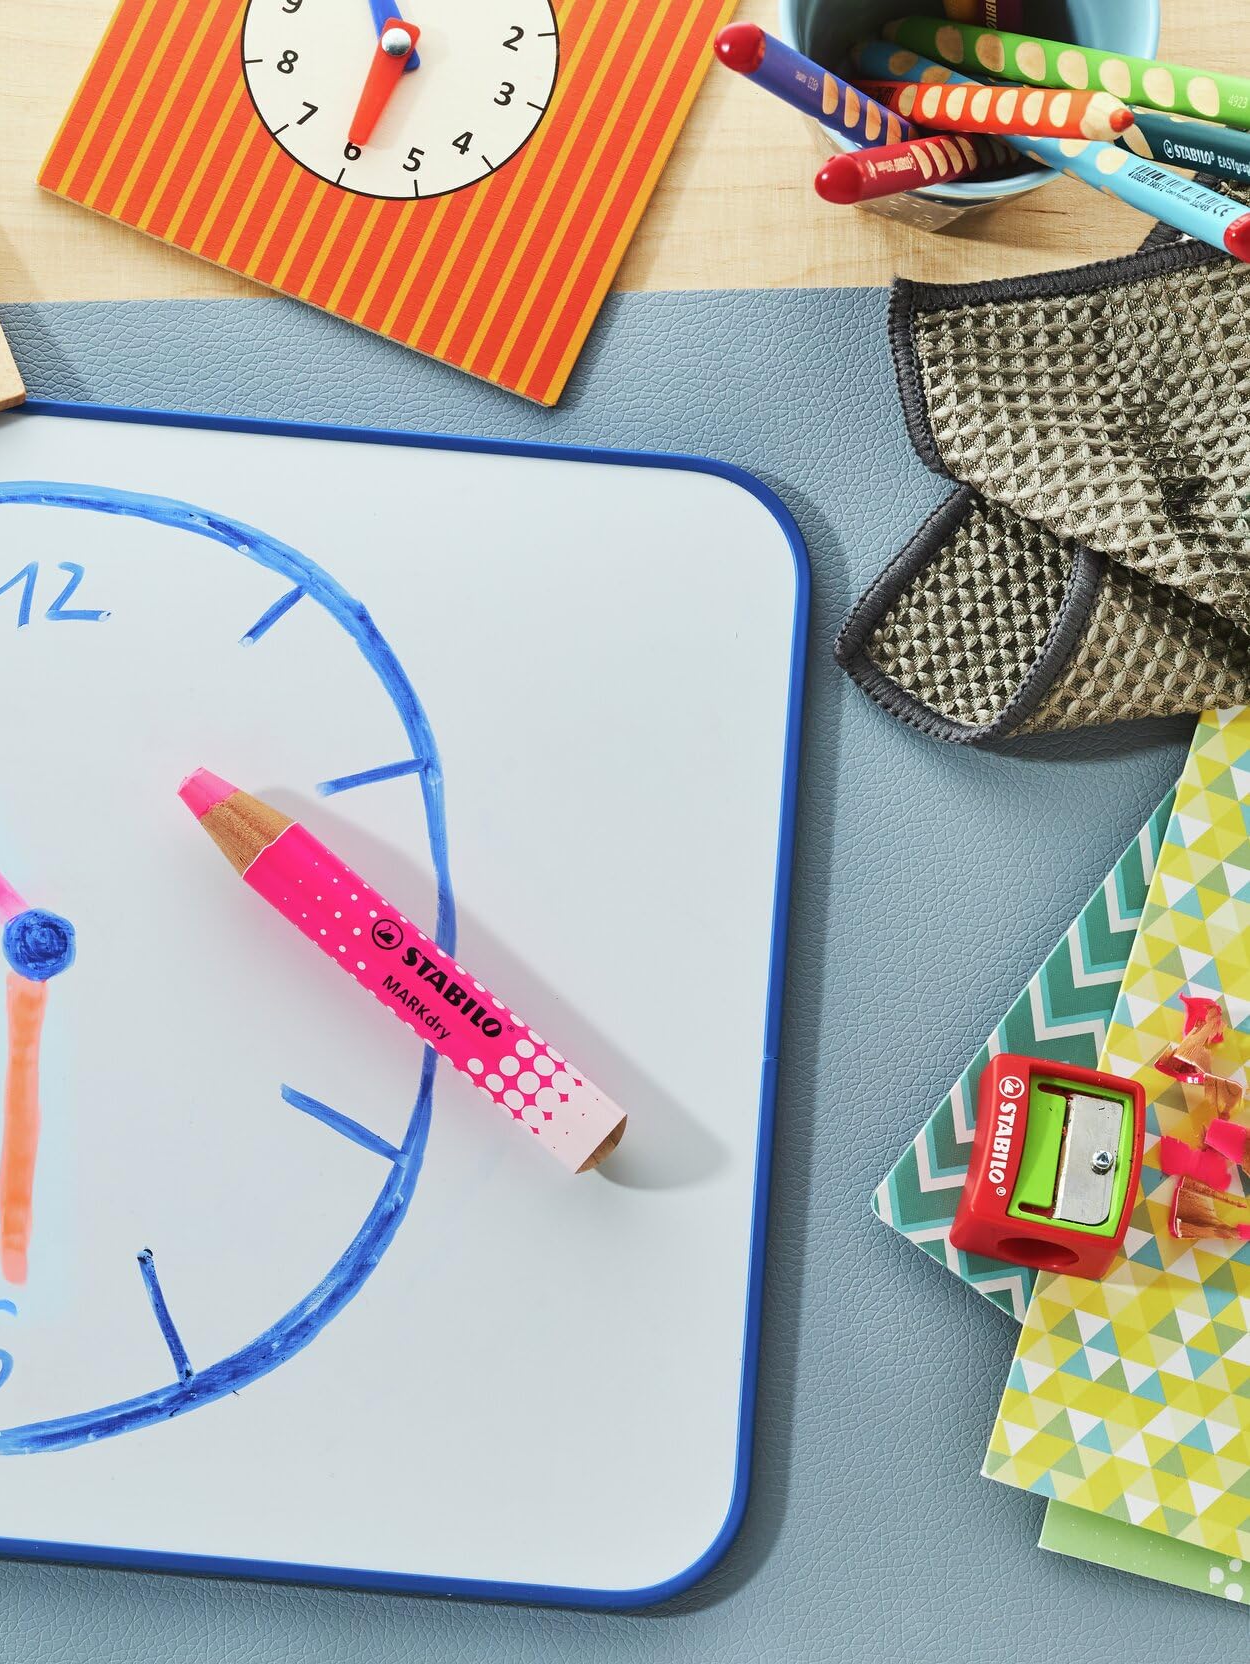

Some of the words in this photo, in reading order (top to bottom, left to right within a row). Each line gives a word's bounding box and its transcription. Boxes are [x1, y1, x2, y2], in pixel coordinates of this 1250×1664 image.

[502, 25, 525, 51] 2
[276, 49, 298, 74] 8
[493, 81, 516, 106] 3
[296, 101, 319, 125] 7
[343, 141, 362, 161] 6
[452, 131, 474, 155] 4
[402, 147, 425, 172] 5
[382, 975, 451, 1040] MARKdry
